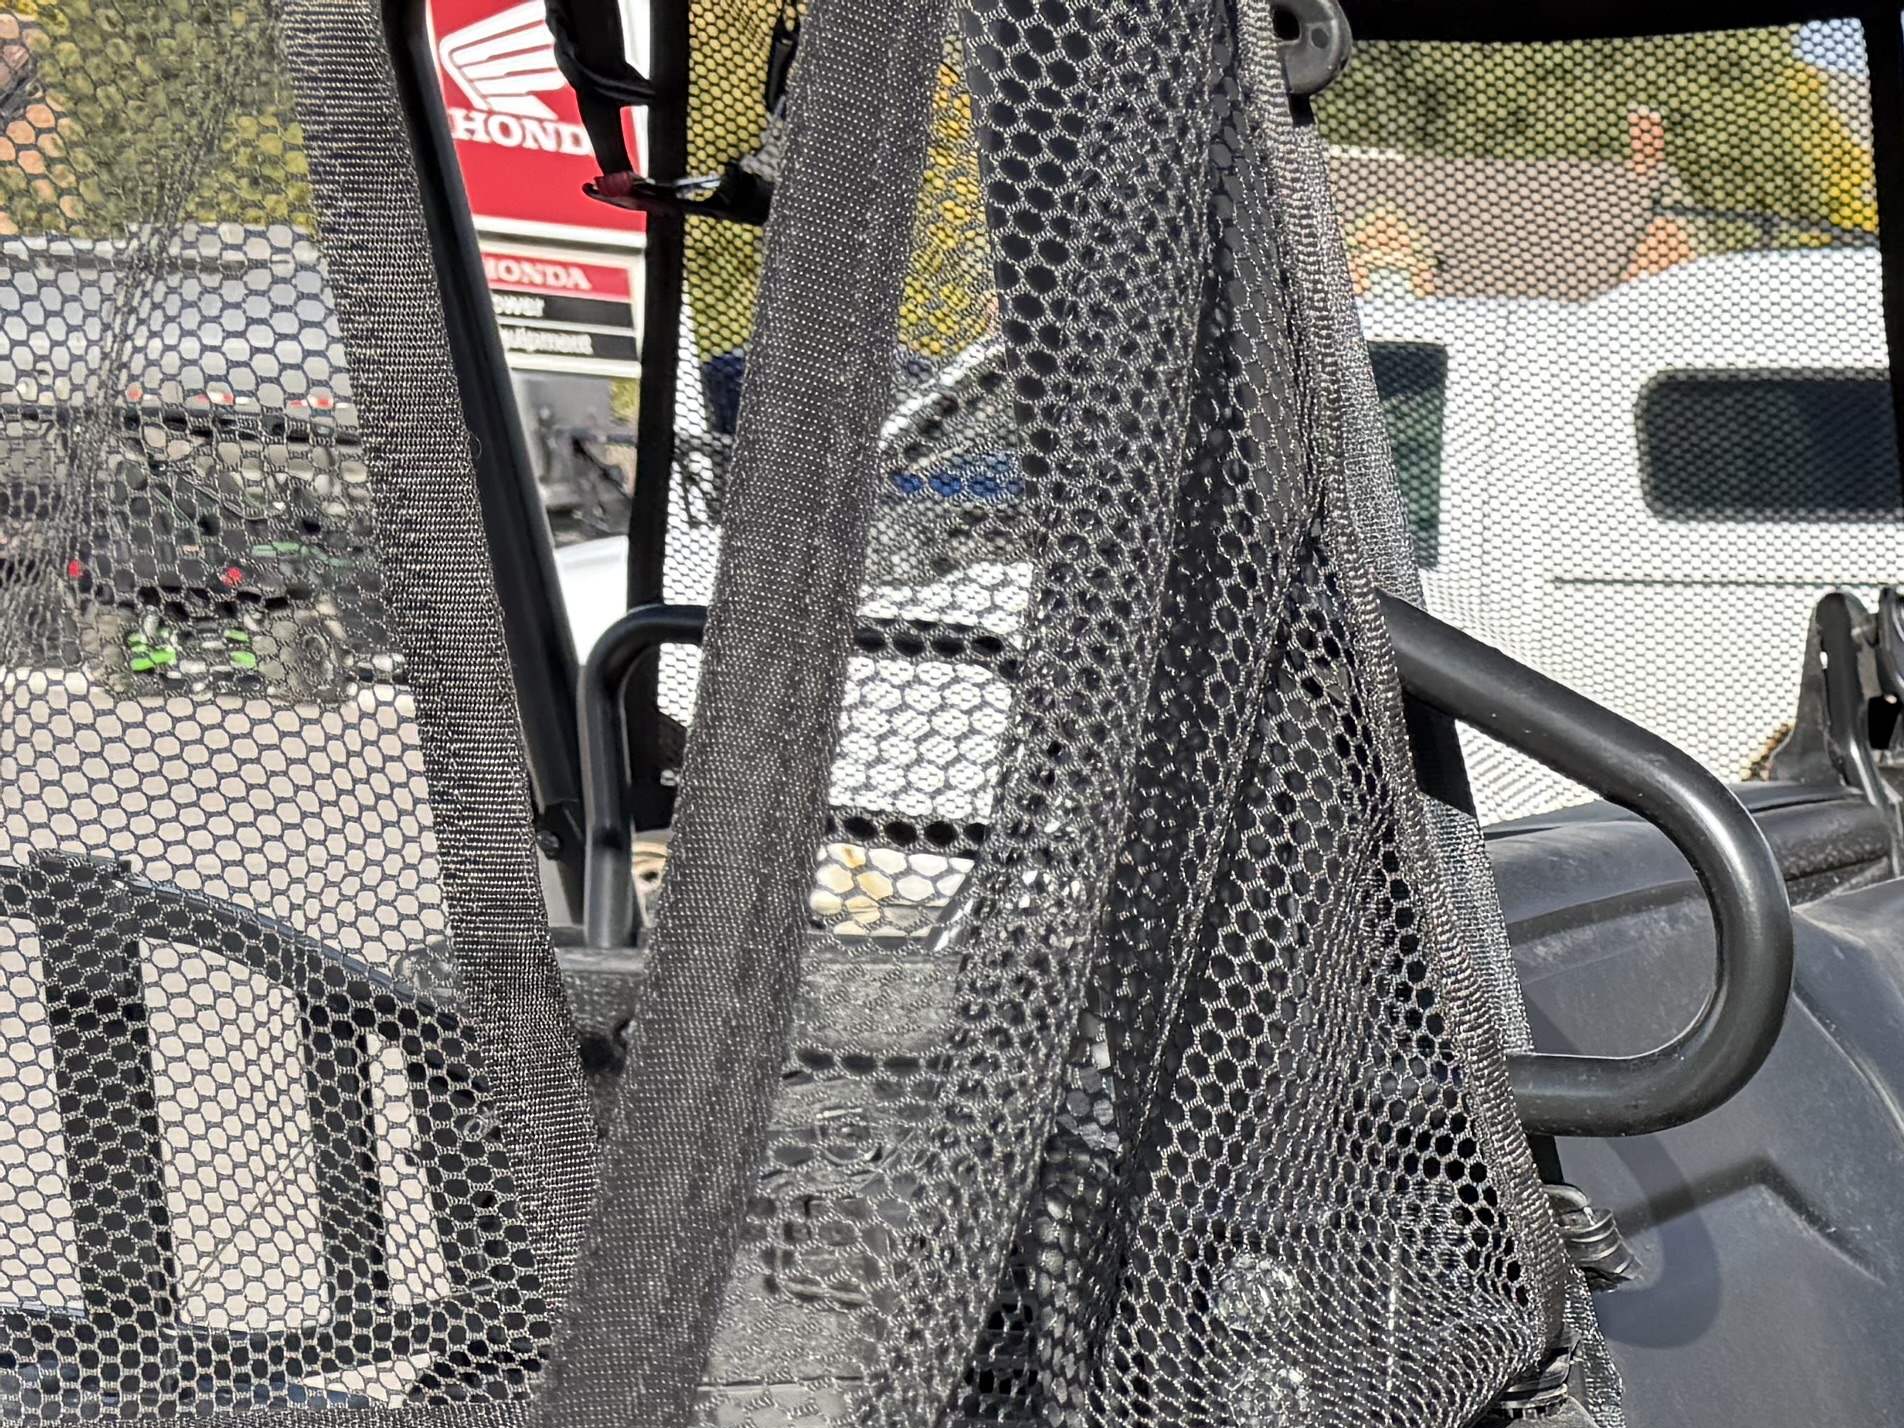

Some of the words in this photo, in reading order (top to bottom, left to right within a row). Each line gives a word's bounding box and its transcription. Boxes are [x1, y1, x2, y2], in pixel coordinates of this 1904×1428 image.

[449, 109, 597, 156] HOND
[491, 291, 545, 317] ower
[500, 326, 593, 355] quipment
